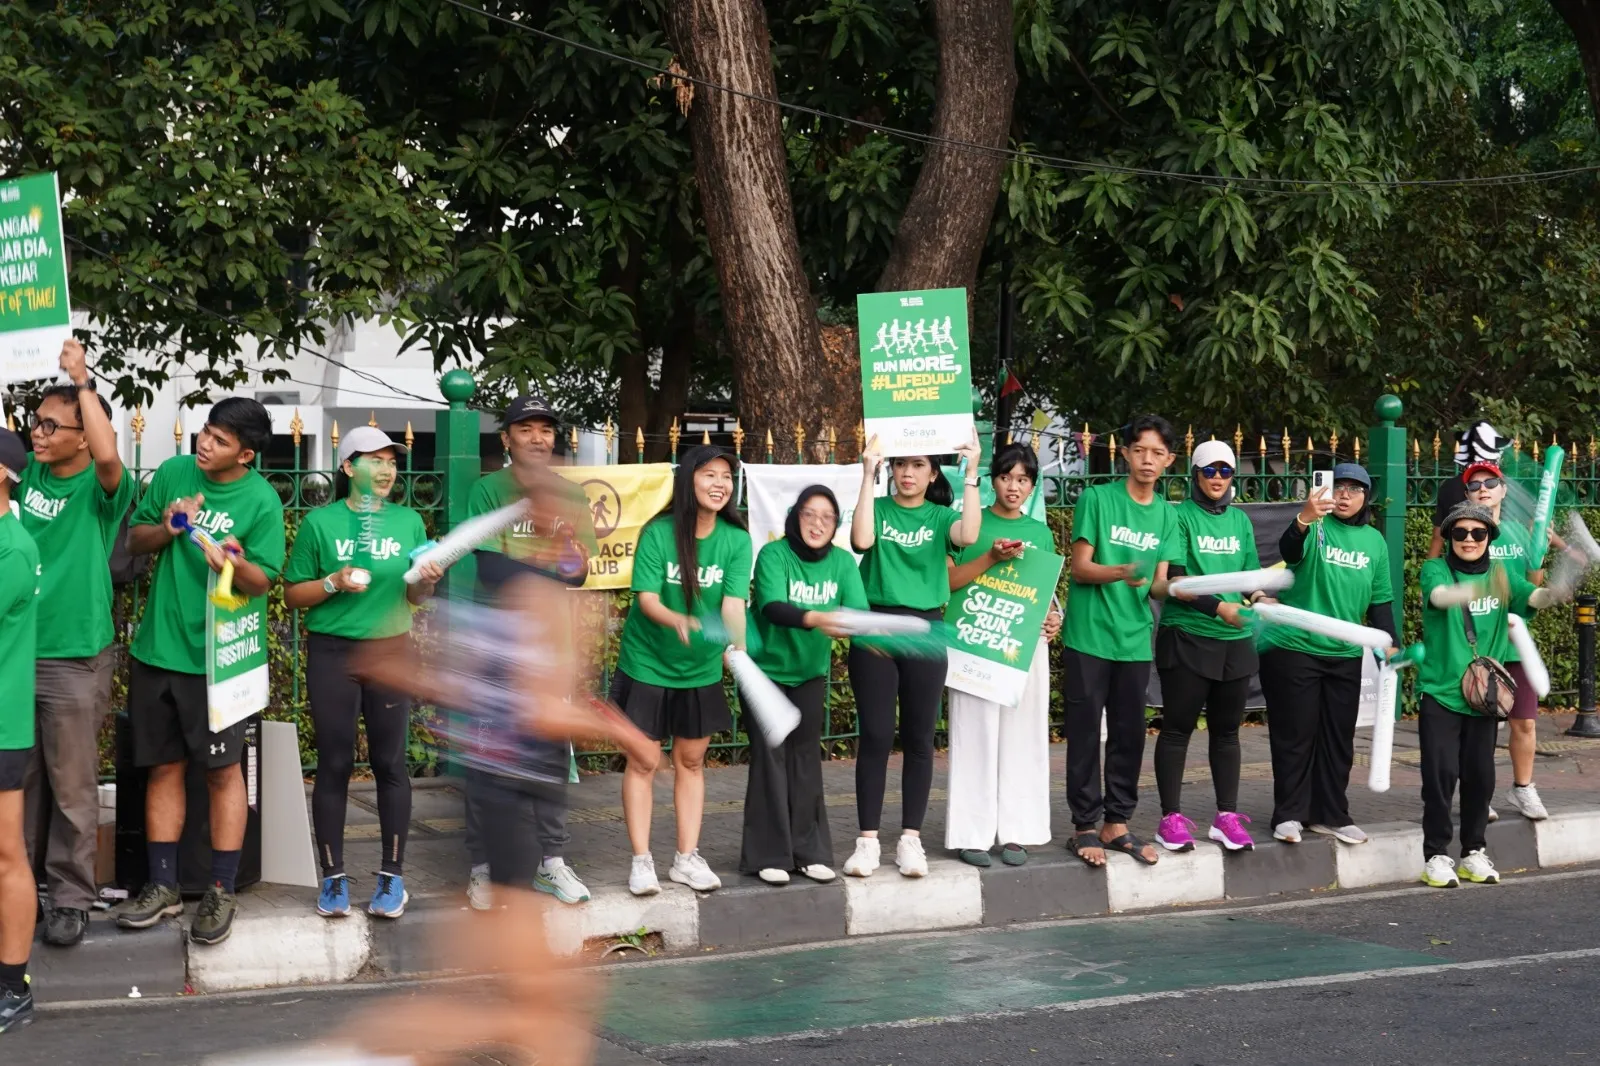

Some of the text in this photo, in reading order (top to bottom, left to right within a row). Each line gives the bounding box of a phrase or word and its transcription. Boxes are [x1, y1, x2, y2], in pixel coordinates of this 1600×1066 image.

[873, 354, 962, 375] RUN MORE,
[871, 373, 956, 391] #LIFEDULU
[892, 386, 940, 402] MORE
[882, 520, 934, 546] VitaLife
[1111, 525, 1160, 551] VitaLife
[335, 537, 402, 560] ViLife
[600, 543, 634, 558] ACE
[1327, 545, 1370, 570] VitaLife
[589, 560, 619, 576] LUB
[790, 579, 838, 605] VitaLife
[963, 586, 1024, 624] SLEEP,
[957, 617, 1023, 655] REPEAT
[974, 612, 1012, 637] RUN,
